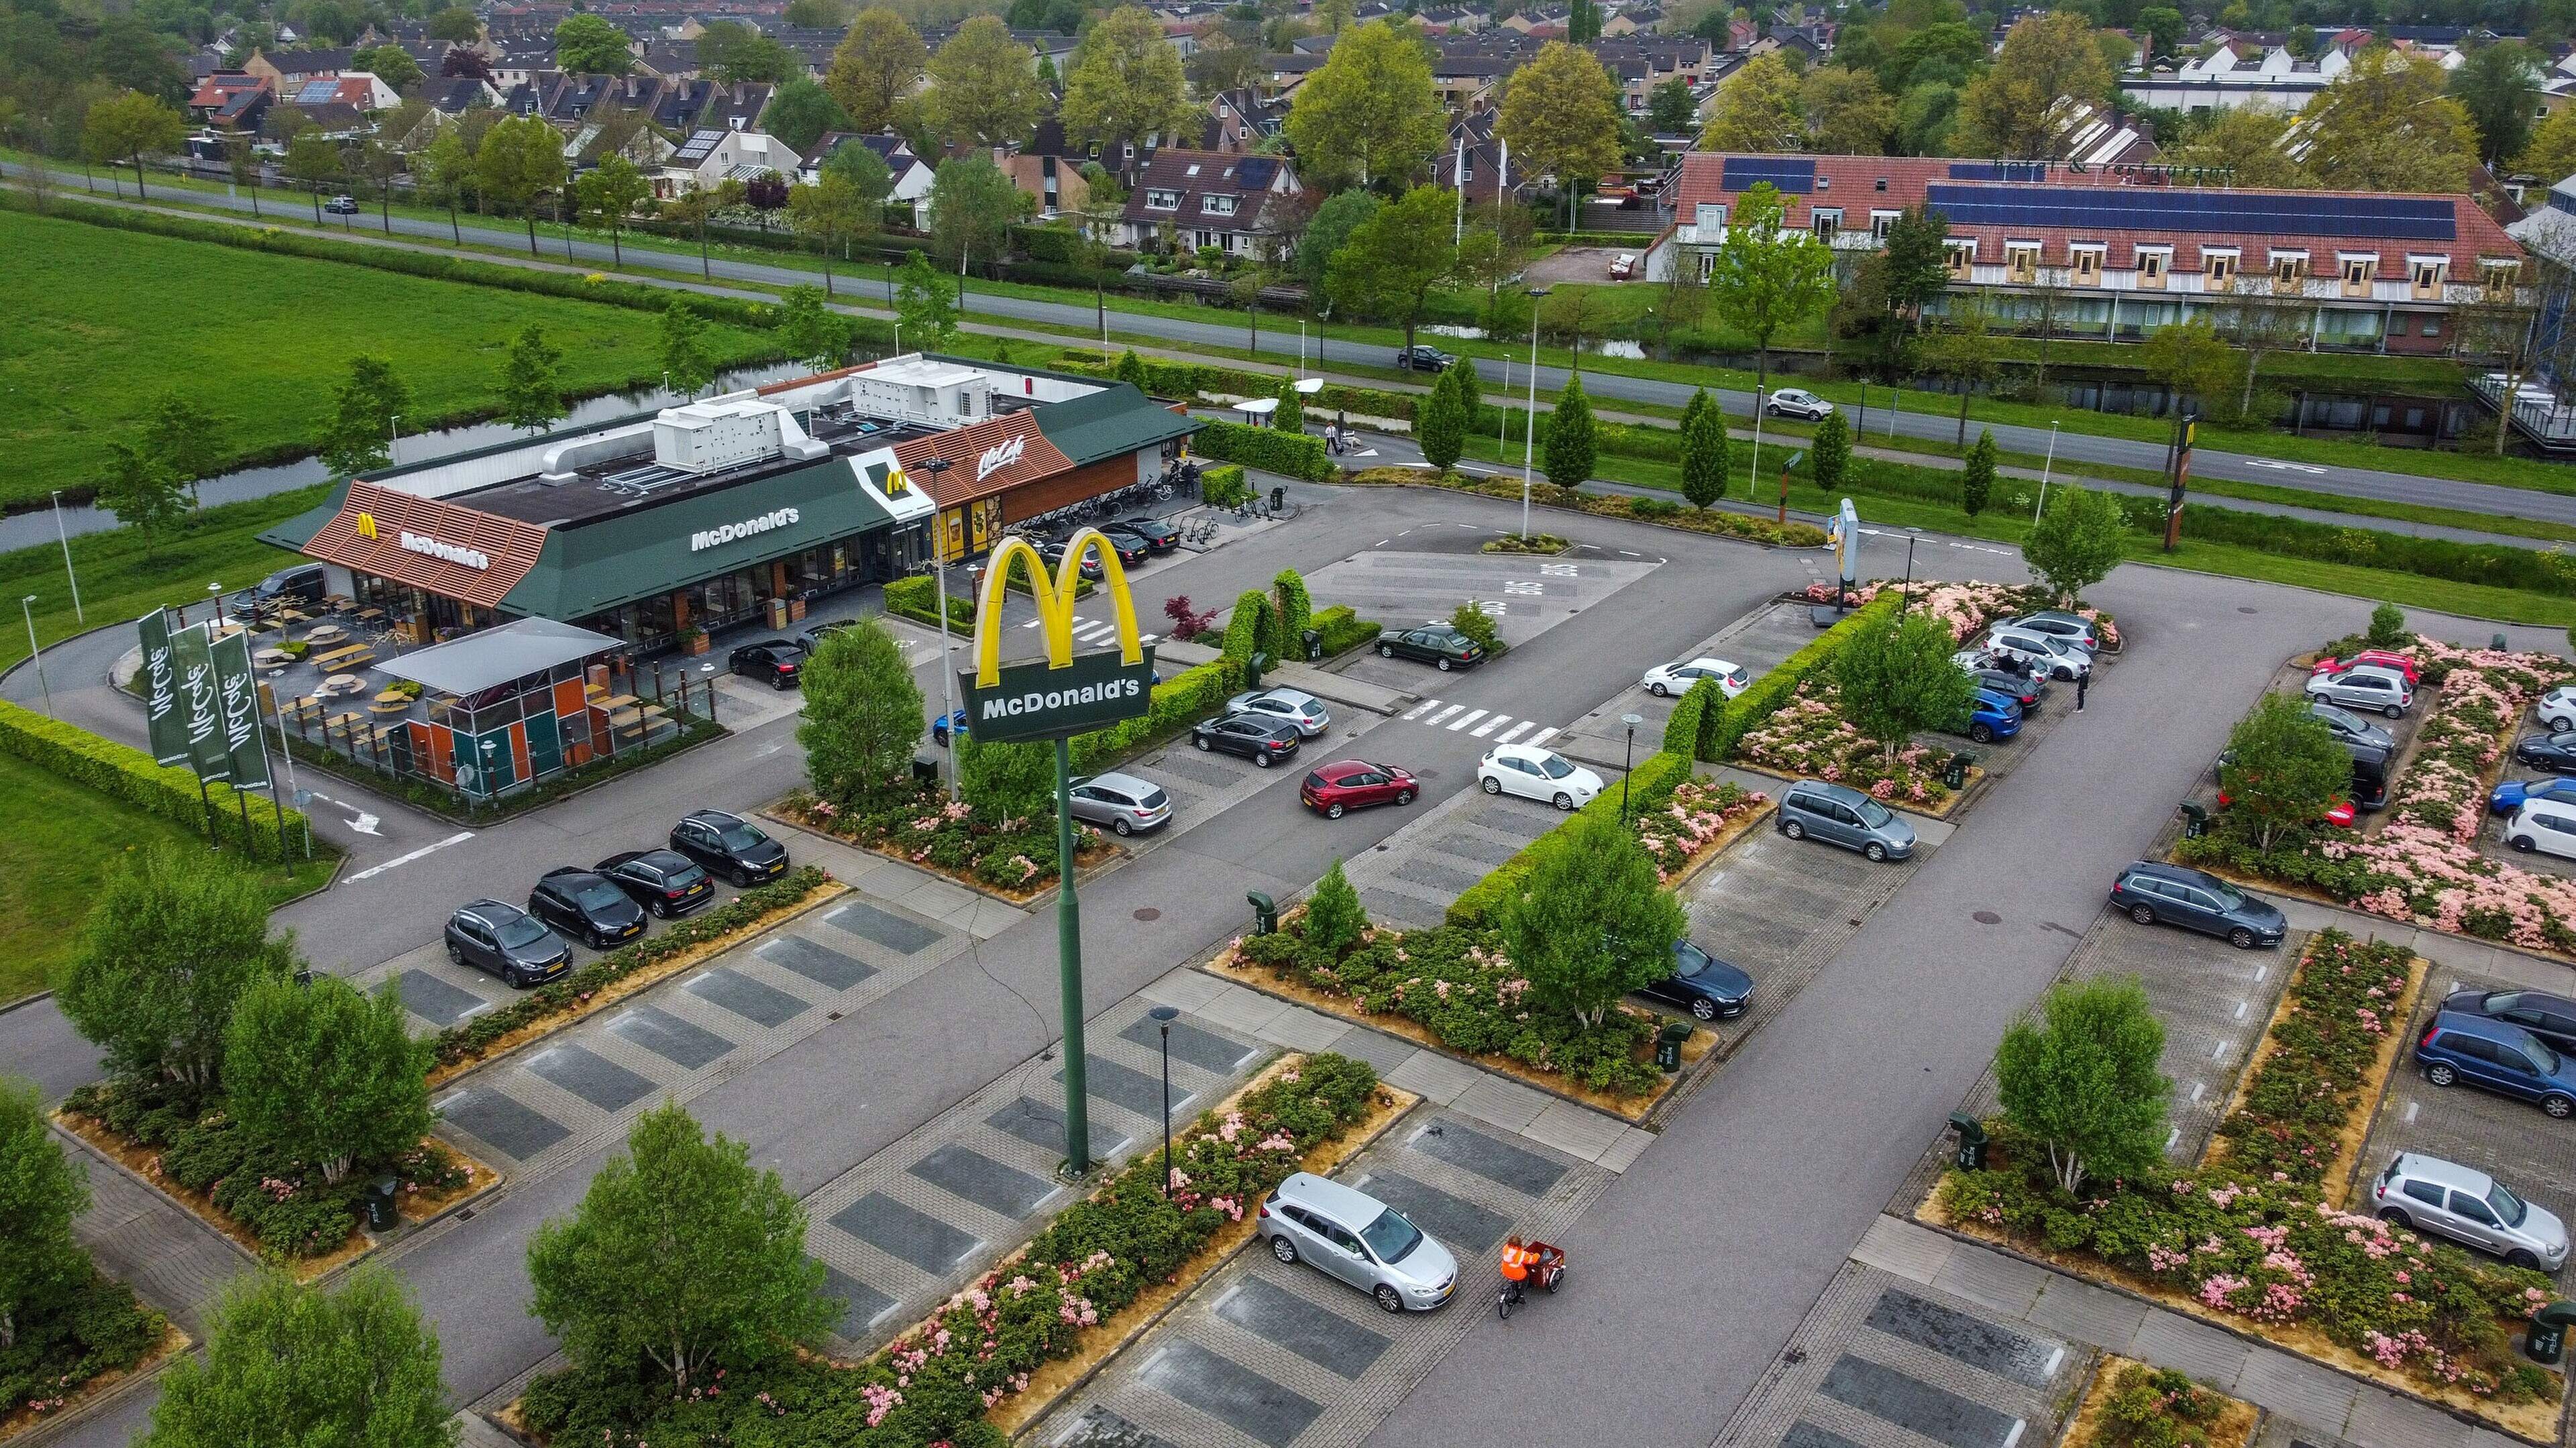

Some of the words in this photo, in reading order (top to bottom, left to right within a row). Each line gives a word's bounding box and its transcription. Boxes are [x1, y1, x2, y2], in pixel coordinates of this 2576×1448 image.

[1994, 154, 2056, 173] hotel
[2069, 158, 2090, 174] &
[2102, 161, 2234, 180] restaurant
[692, 508, 799, 551] McDonald's
[401, 531, 489, 570] McDonald's
[1540, 563, 1578, 577] BUS
[1504, 581, 1544, 596] BUS
[983, 679, 1140, 720] McDonald's
